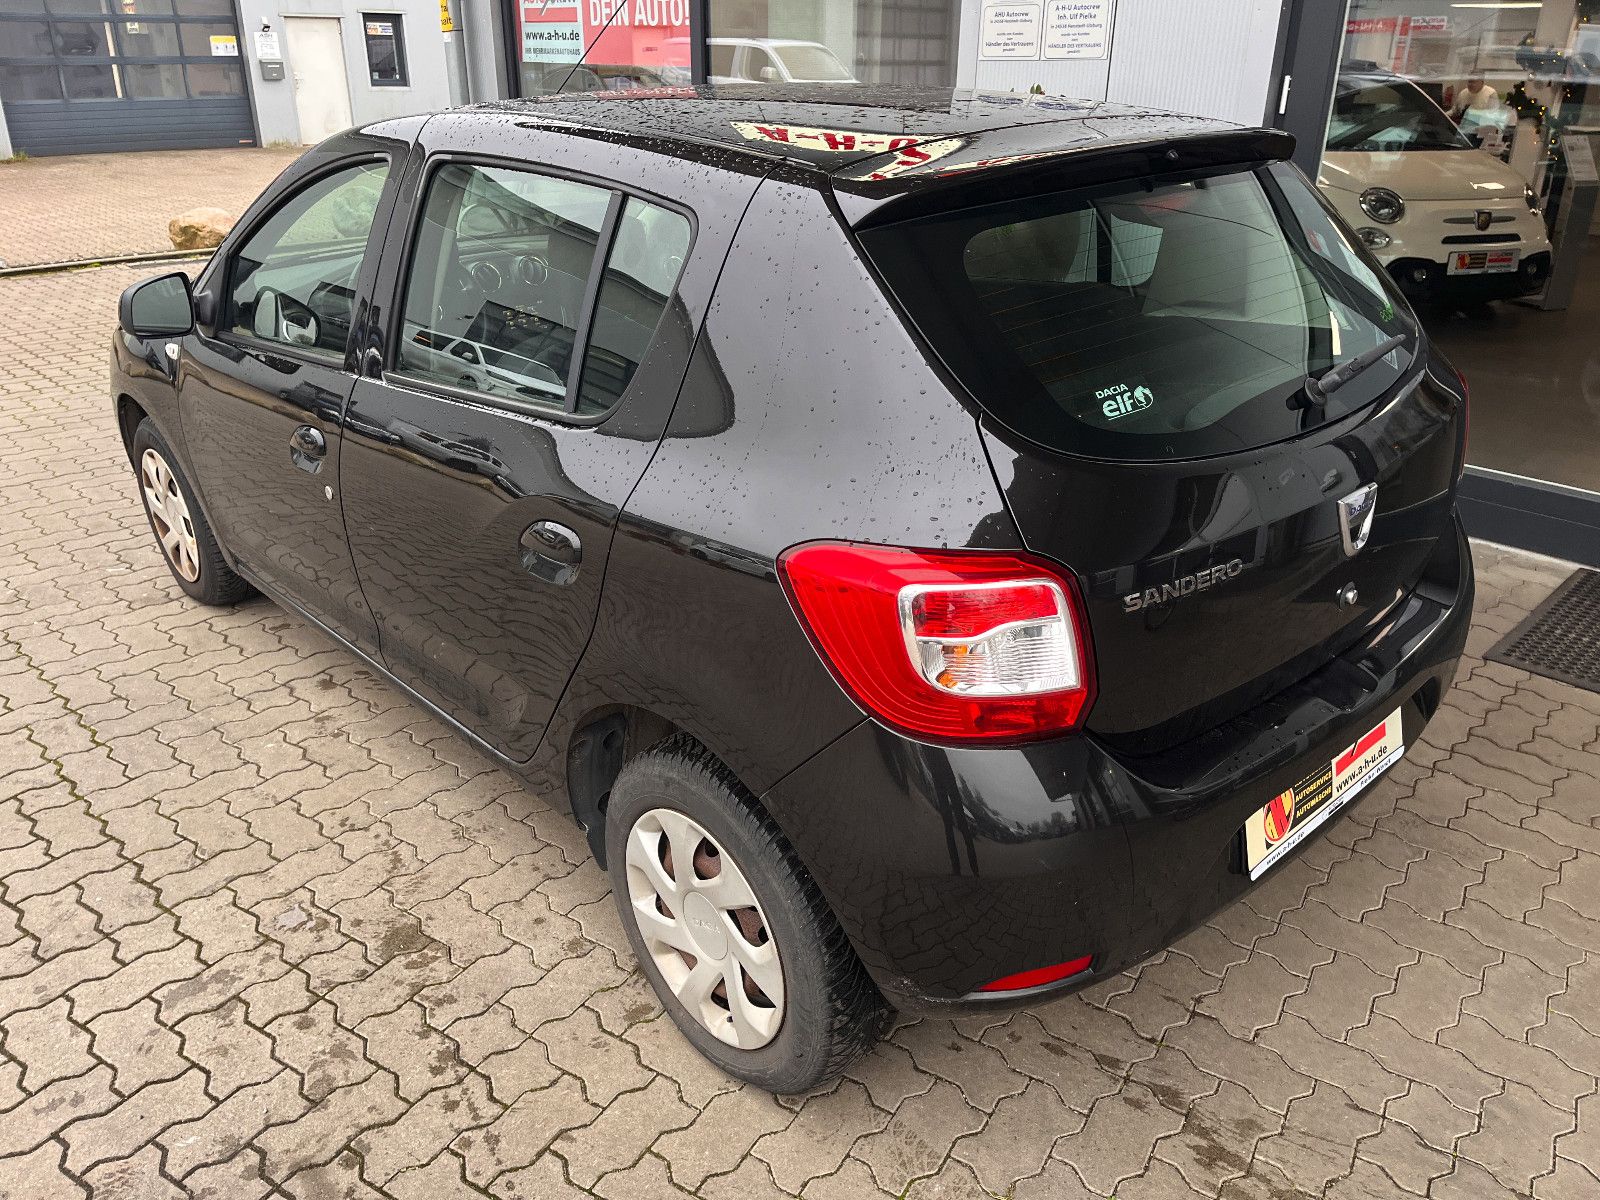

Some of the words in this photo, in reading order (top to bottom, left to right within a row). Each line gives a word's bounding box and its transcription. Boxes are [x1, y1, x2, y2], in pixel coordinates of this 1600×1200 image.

[590, 0, 629, 26] DEIN
[634, 0, 690, 26] AUTO!
[524, 29, 580, 41] www.a-h-u.de
[1095, 383, 1129, 399] DACIA
[1103, 390, 1135, 418] elf
[1122, 558, 1244, 613] SANDERO
[1335, 745, 1388, 793] www.a-h-u.de
[1295, 770, 1332, 803] AUTOSERVICE
